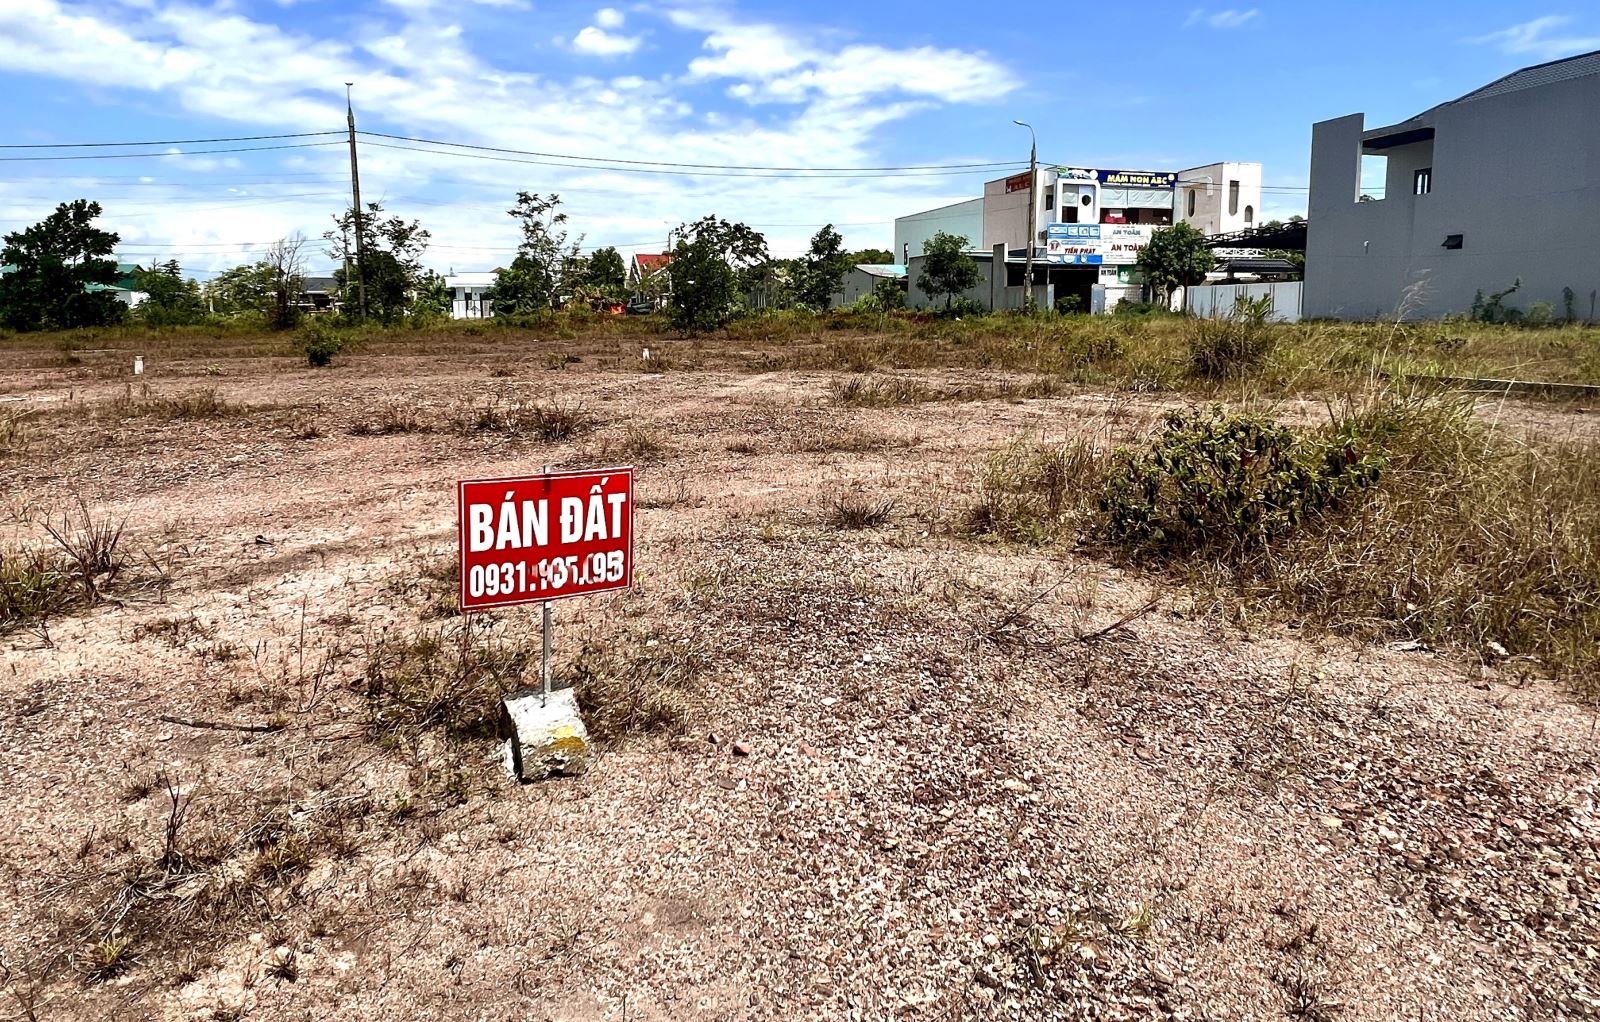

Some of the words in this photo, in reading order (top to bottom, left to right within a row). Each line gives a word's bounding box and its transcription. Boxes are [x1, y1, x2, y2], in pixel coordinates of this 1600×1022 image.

[1130, 176, 1149, 184] NON
[1150, 176, 1168, 184] ABC
[469, 490, 549, 552] BÁN
[559, 476, 627, 544] ĐẤT
